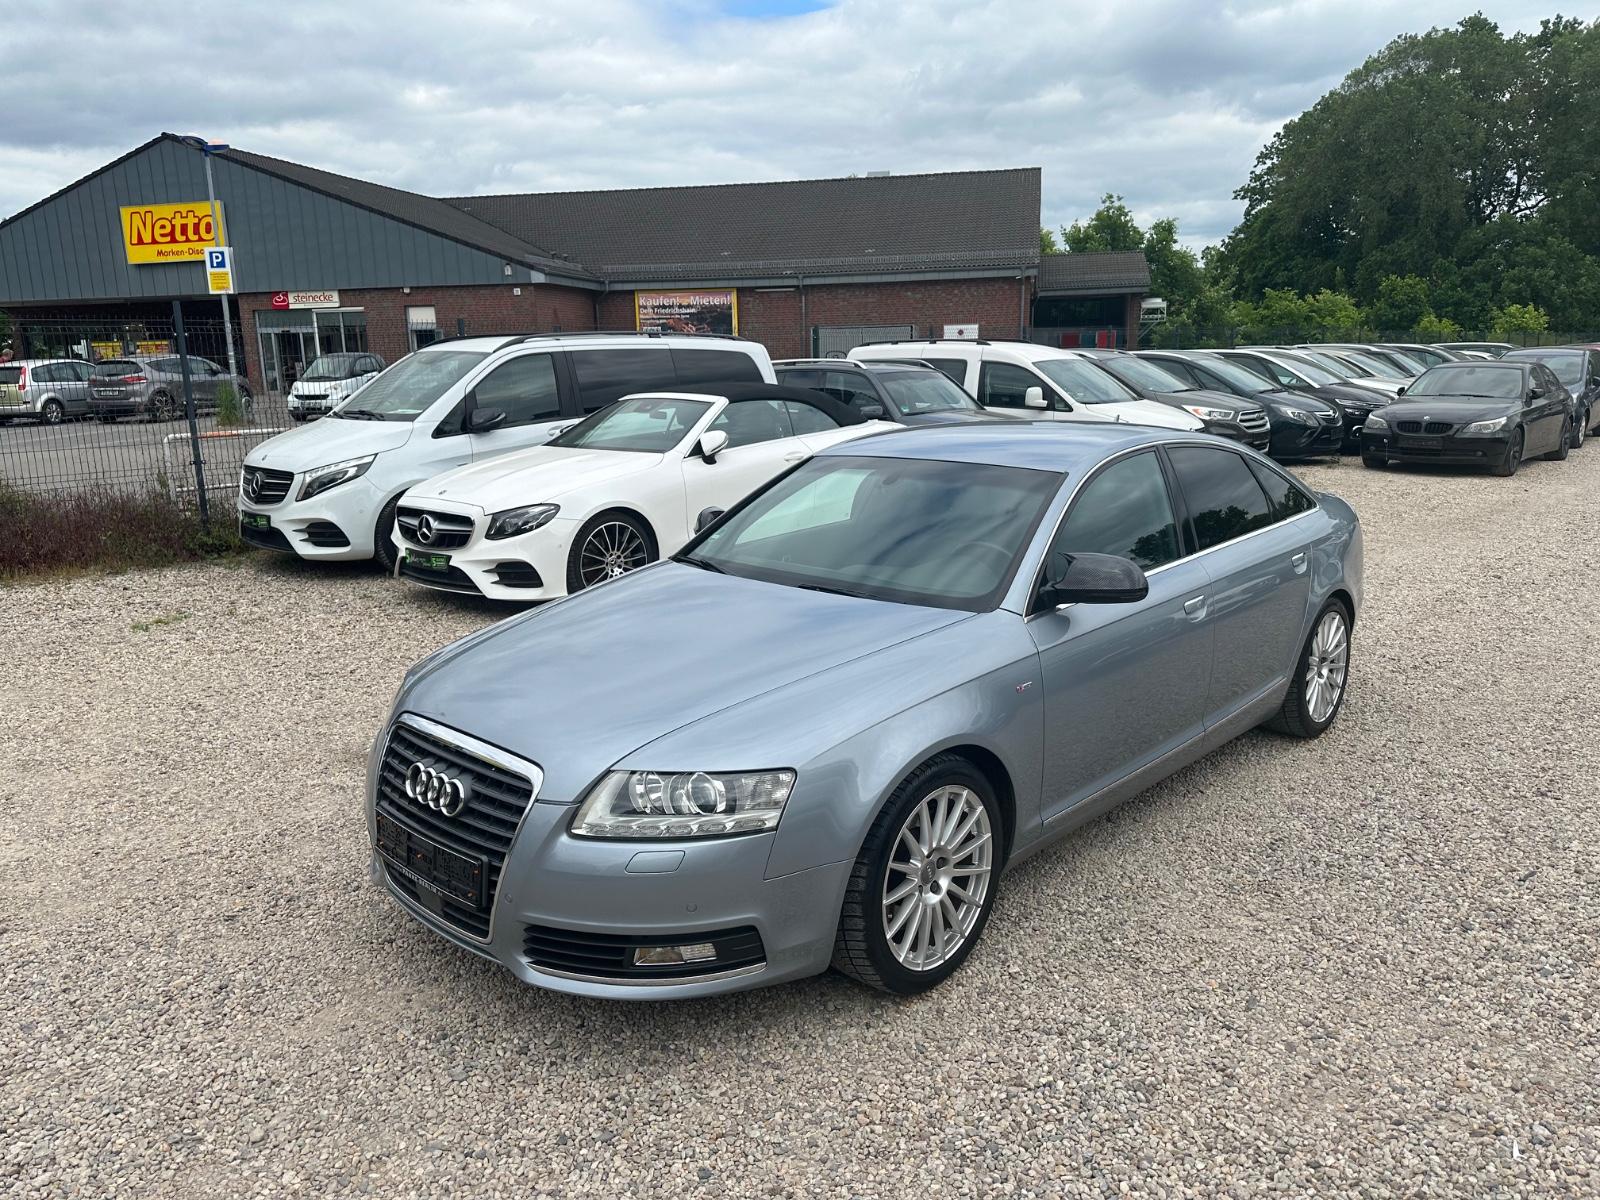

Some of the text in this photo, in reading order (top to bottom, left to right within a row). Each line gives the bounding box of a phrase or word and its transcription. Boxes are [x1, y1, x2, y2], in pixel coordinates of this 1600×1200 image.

[130, 210, 215, 246] Netto
[156, 247, 205, 257] Marken-Disc
[212, 253, 223, 267] P
[293, 292, 333, 302] steinecke
[640, 295, 680, 306] Kaufen!
[690, 295, 730, 305] Mieten!
